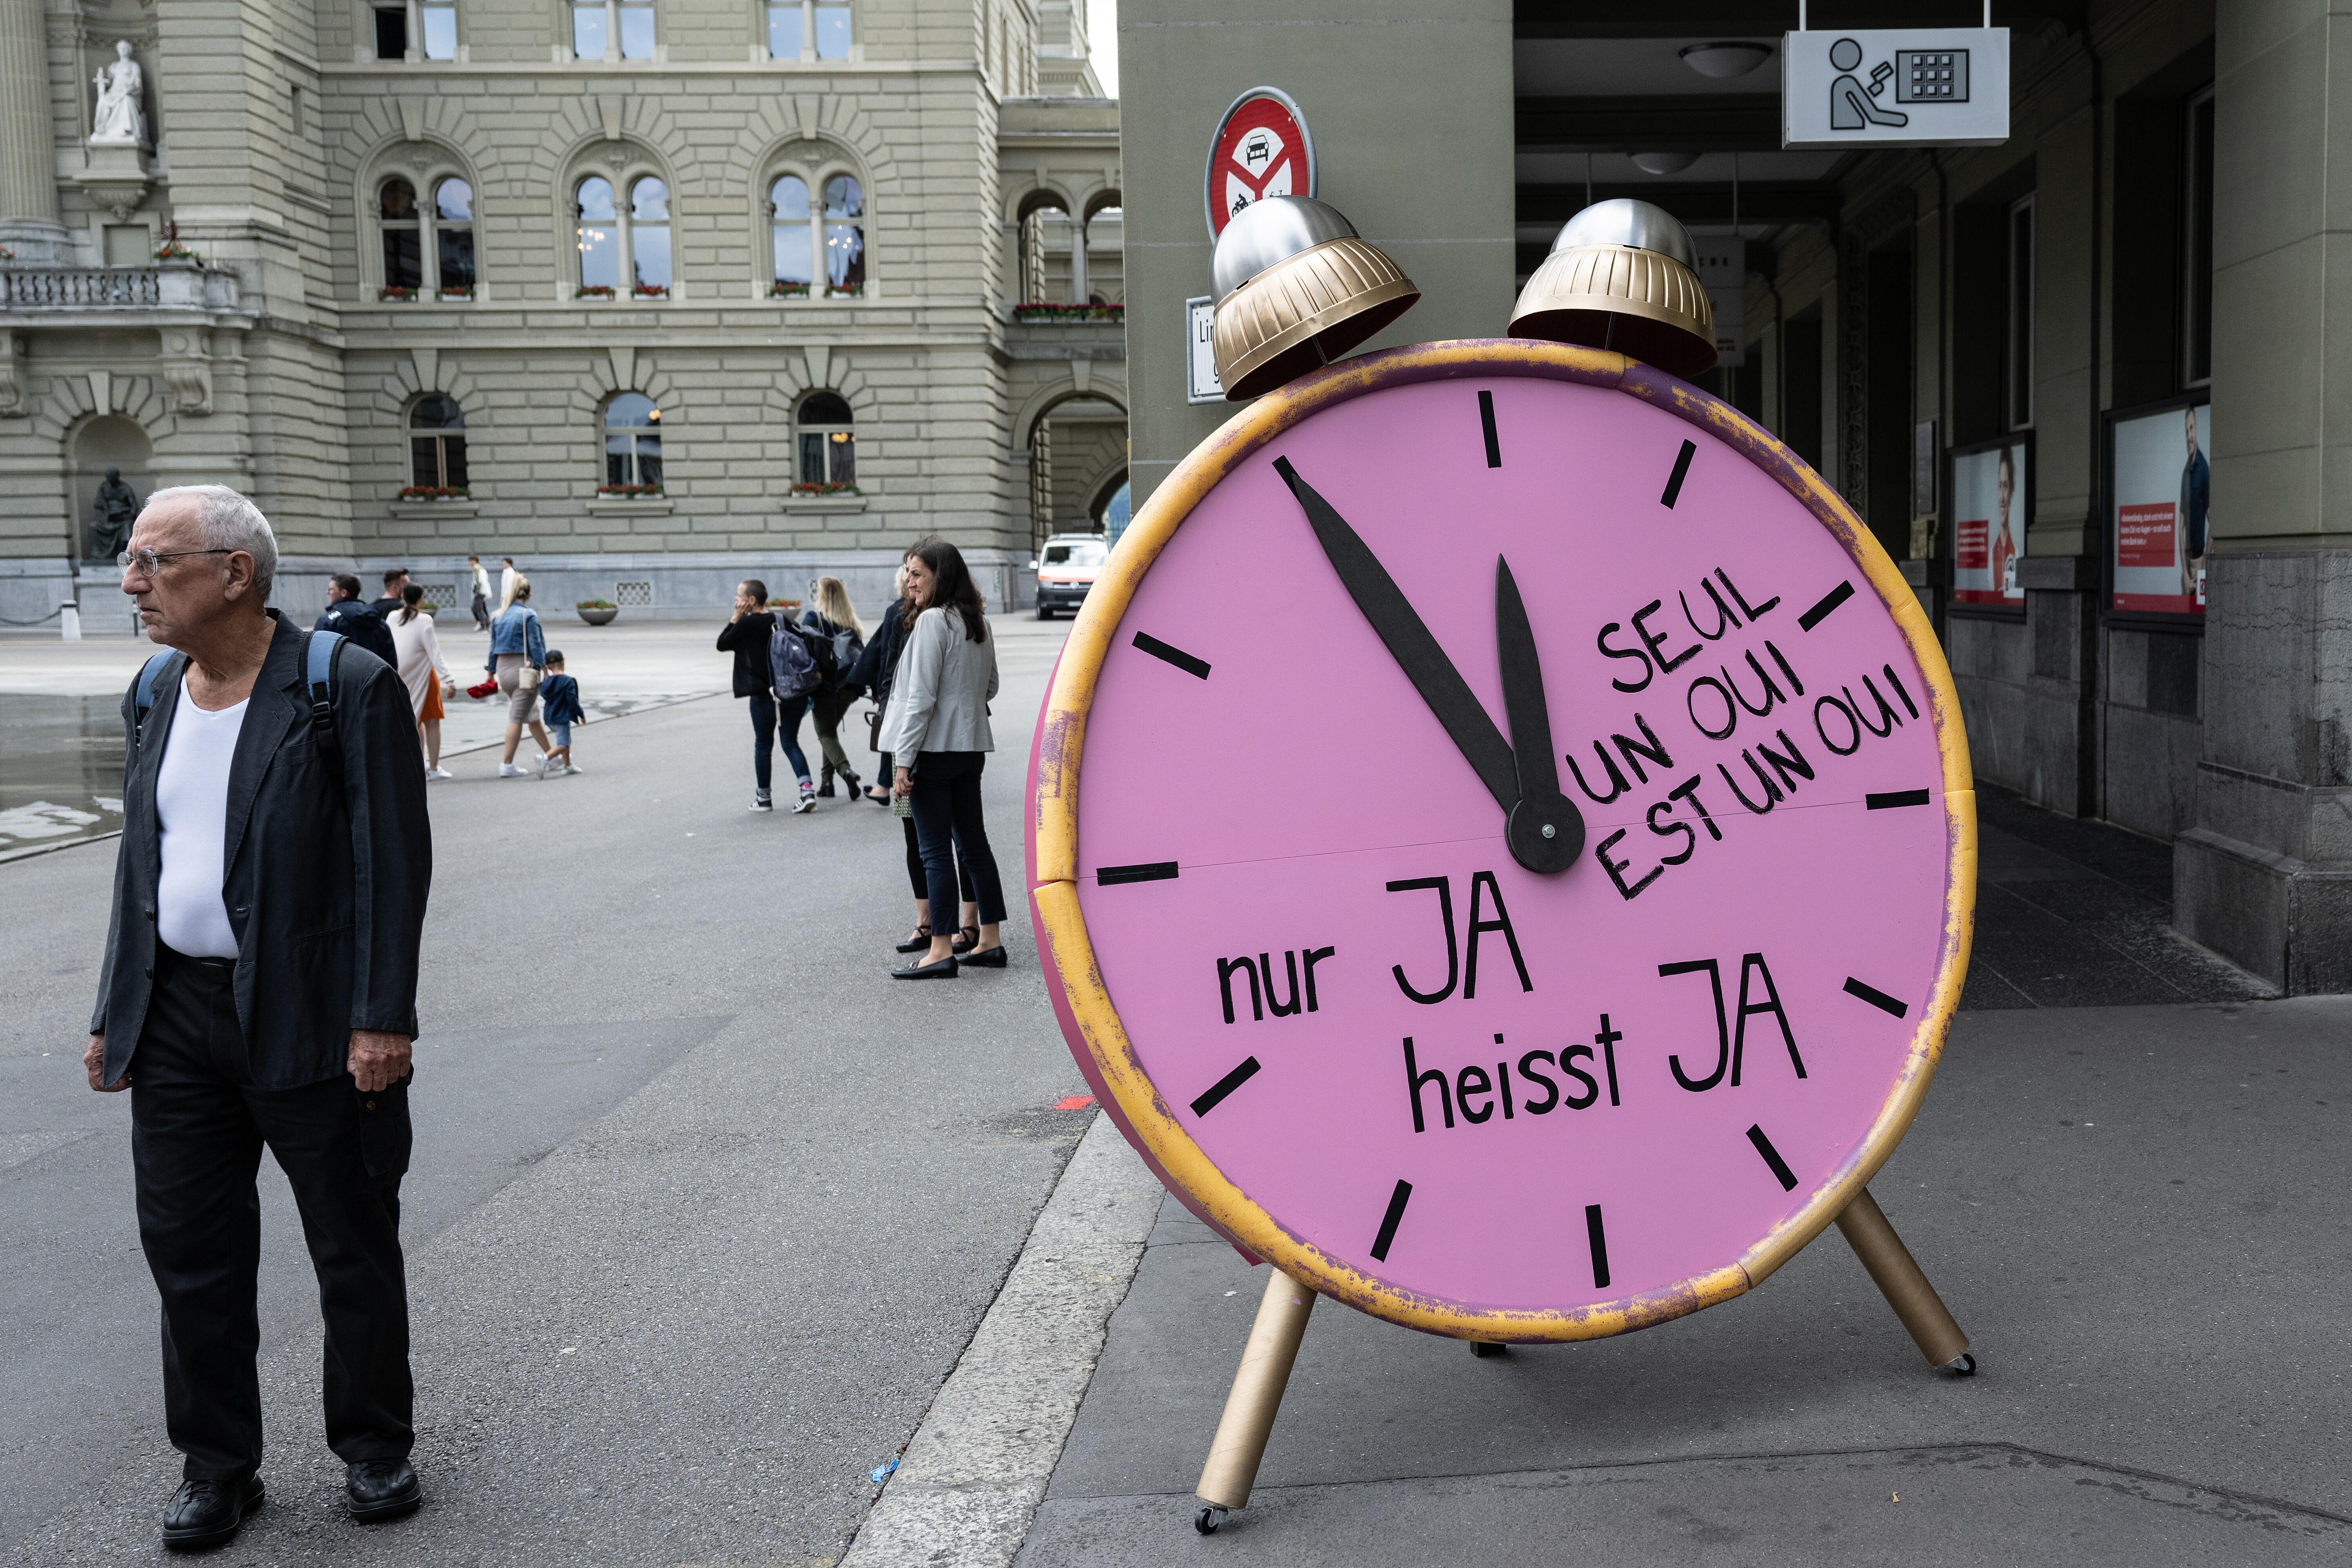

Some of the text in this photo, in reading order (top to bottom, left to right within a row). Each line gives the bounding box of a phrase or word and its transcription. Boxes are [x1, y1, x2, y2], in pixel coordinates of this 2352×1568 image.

[1597, 566, 1781, 693] SEUL
[1565, 640, 1805, 805] UN OUI
[1594, 663, 1920, 901] EST UN OUI
[1216, 870, 1534, 1025] nur JA
[1402, 952, 1808, 1134] heisst JA
